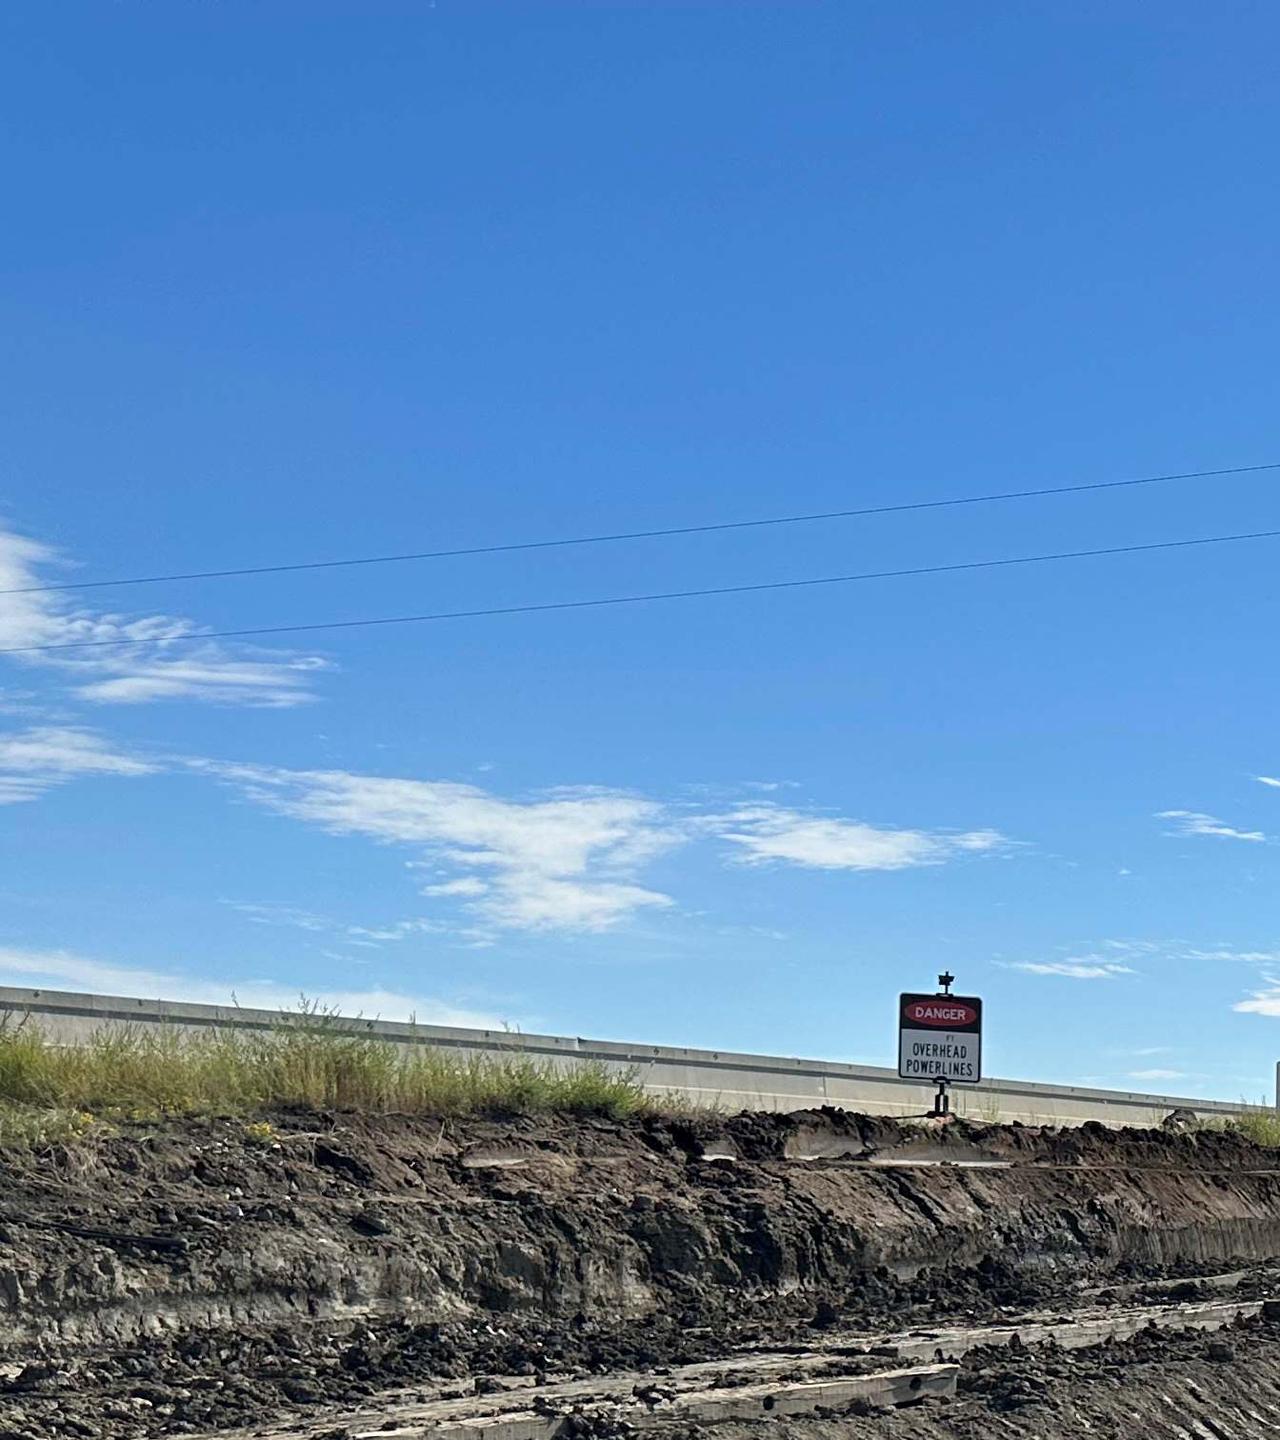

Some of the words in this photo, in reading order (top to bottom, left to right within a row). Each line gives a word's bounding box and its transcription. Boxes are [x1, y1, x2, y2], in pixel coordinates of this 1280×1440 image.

[915, 1006, 966, 1020] DANGER
[913, 1042, 967, 1058] OVERHEAD
[906, 1059, 973, 1076] POWERLINES
